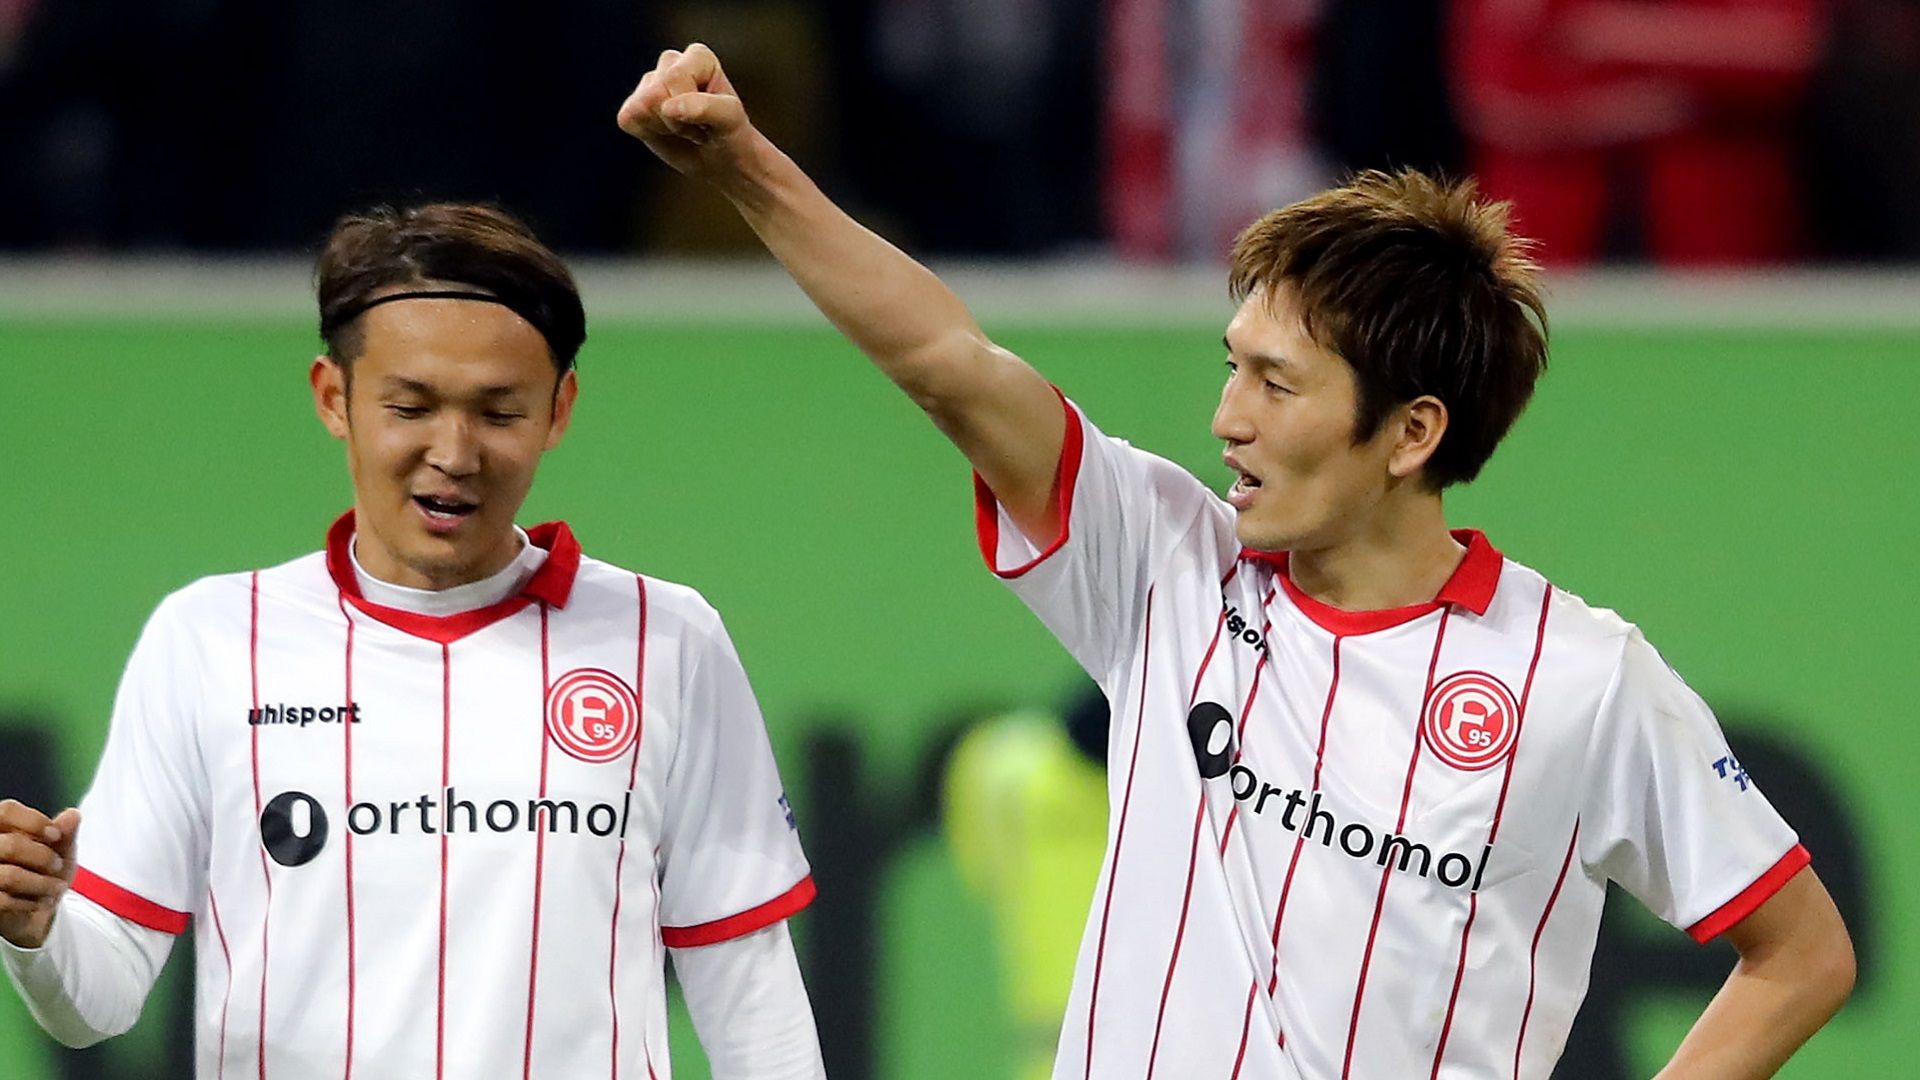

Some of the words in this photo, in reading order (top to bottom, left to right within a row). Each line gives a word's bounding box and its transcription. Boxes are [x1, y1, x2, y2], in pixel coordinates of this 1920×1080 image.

[248, 702, 361, 728] uhlsport
[592, 722, 616, 740] 95
[1468, 728, 1492, 747] 95
[348, 787, 631, 837] orthomol
[1230, 764, 1492, 888] orthomol
